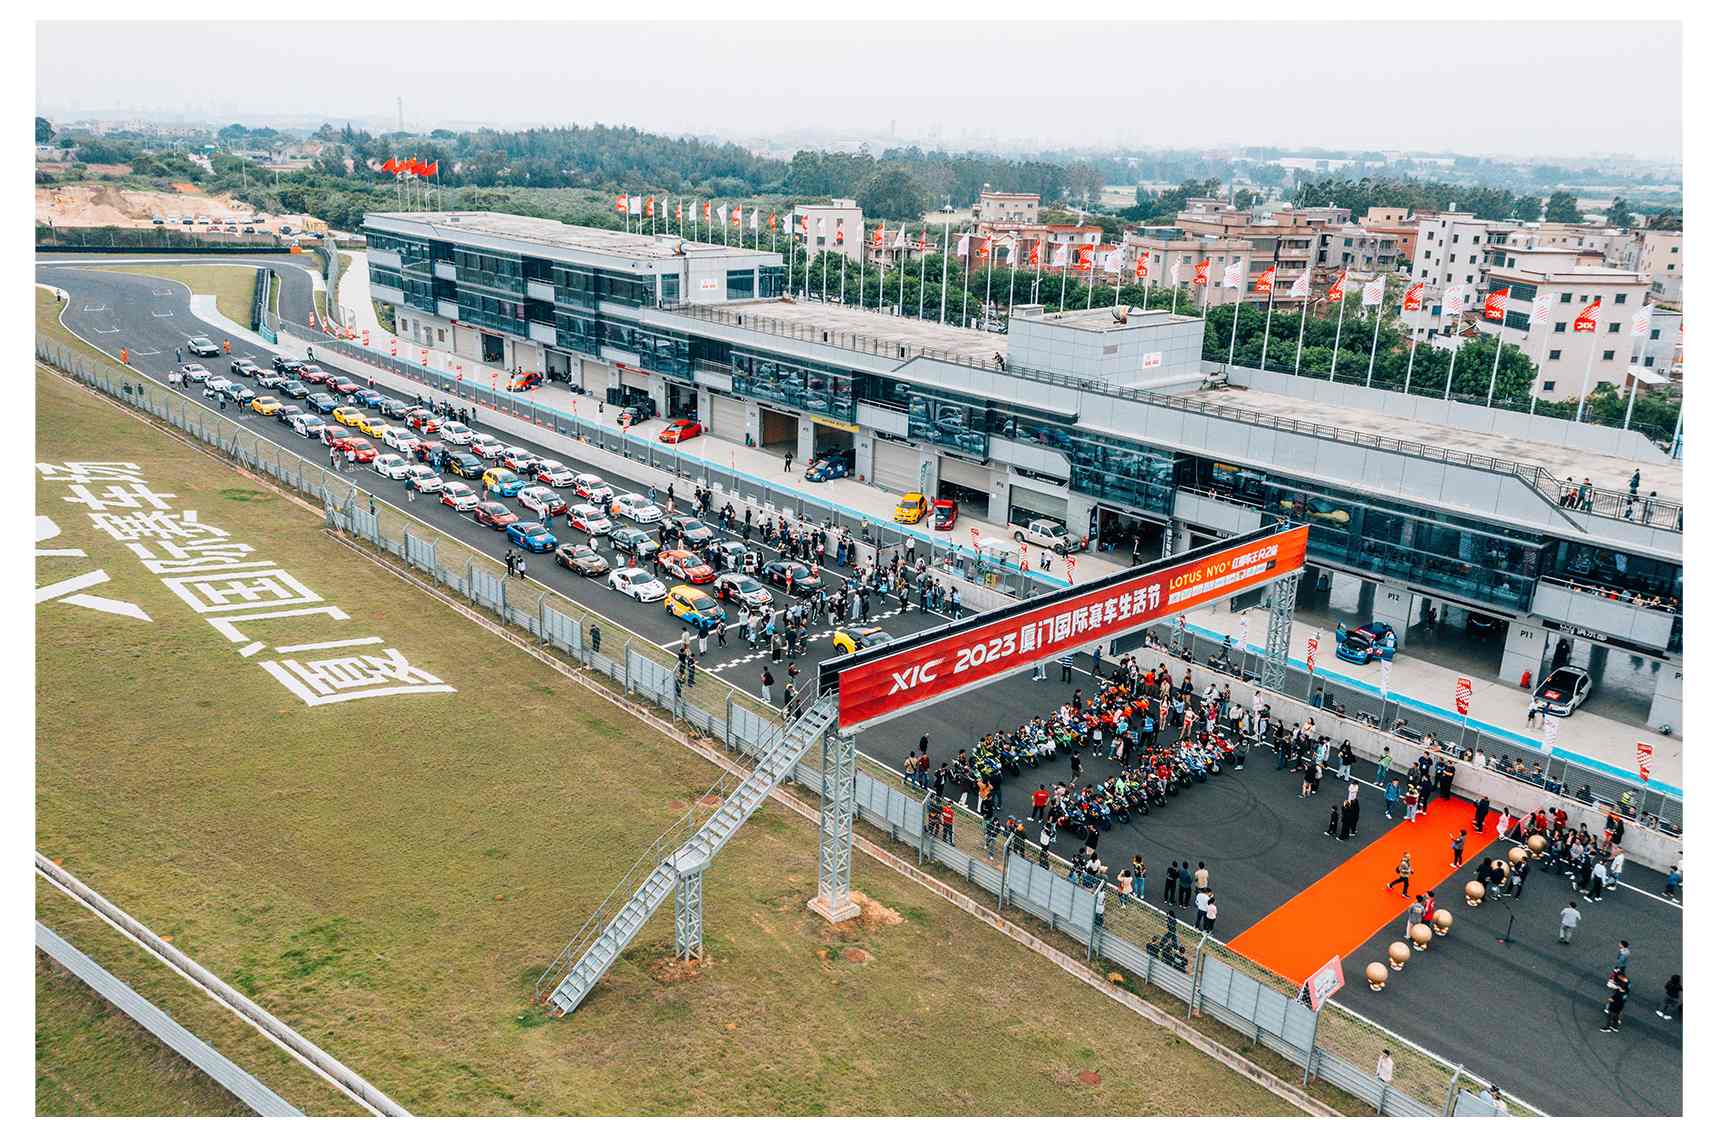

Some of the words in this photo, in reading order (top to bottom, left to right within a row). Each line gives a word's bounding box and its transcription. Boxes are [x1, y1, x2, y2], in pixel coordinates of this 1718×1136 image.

[1168, 569, 1202, 590] LOTUS
[1206, 563, 1226, 579] NYO
[1387, 592, 1400, 601] P12
[1520, 630, 1533, 639] P11
[887, 658, 945, 695] XIC
